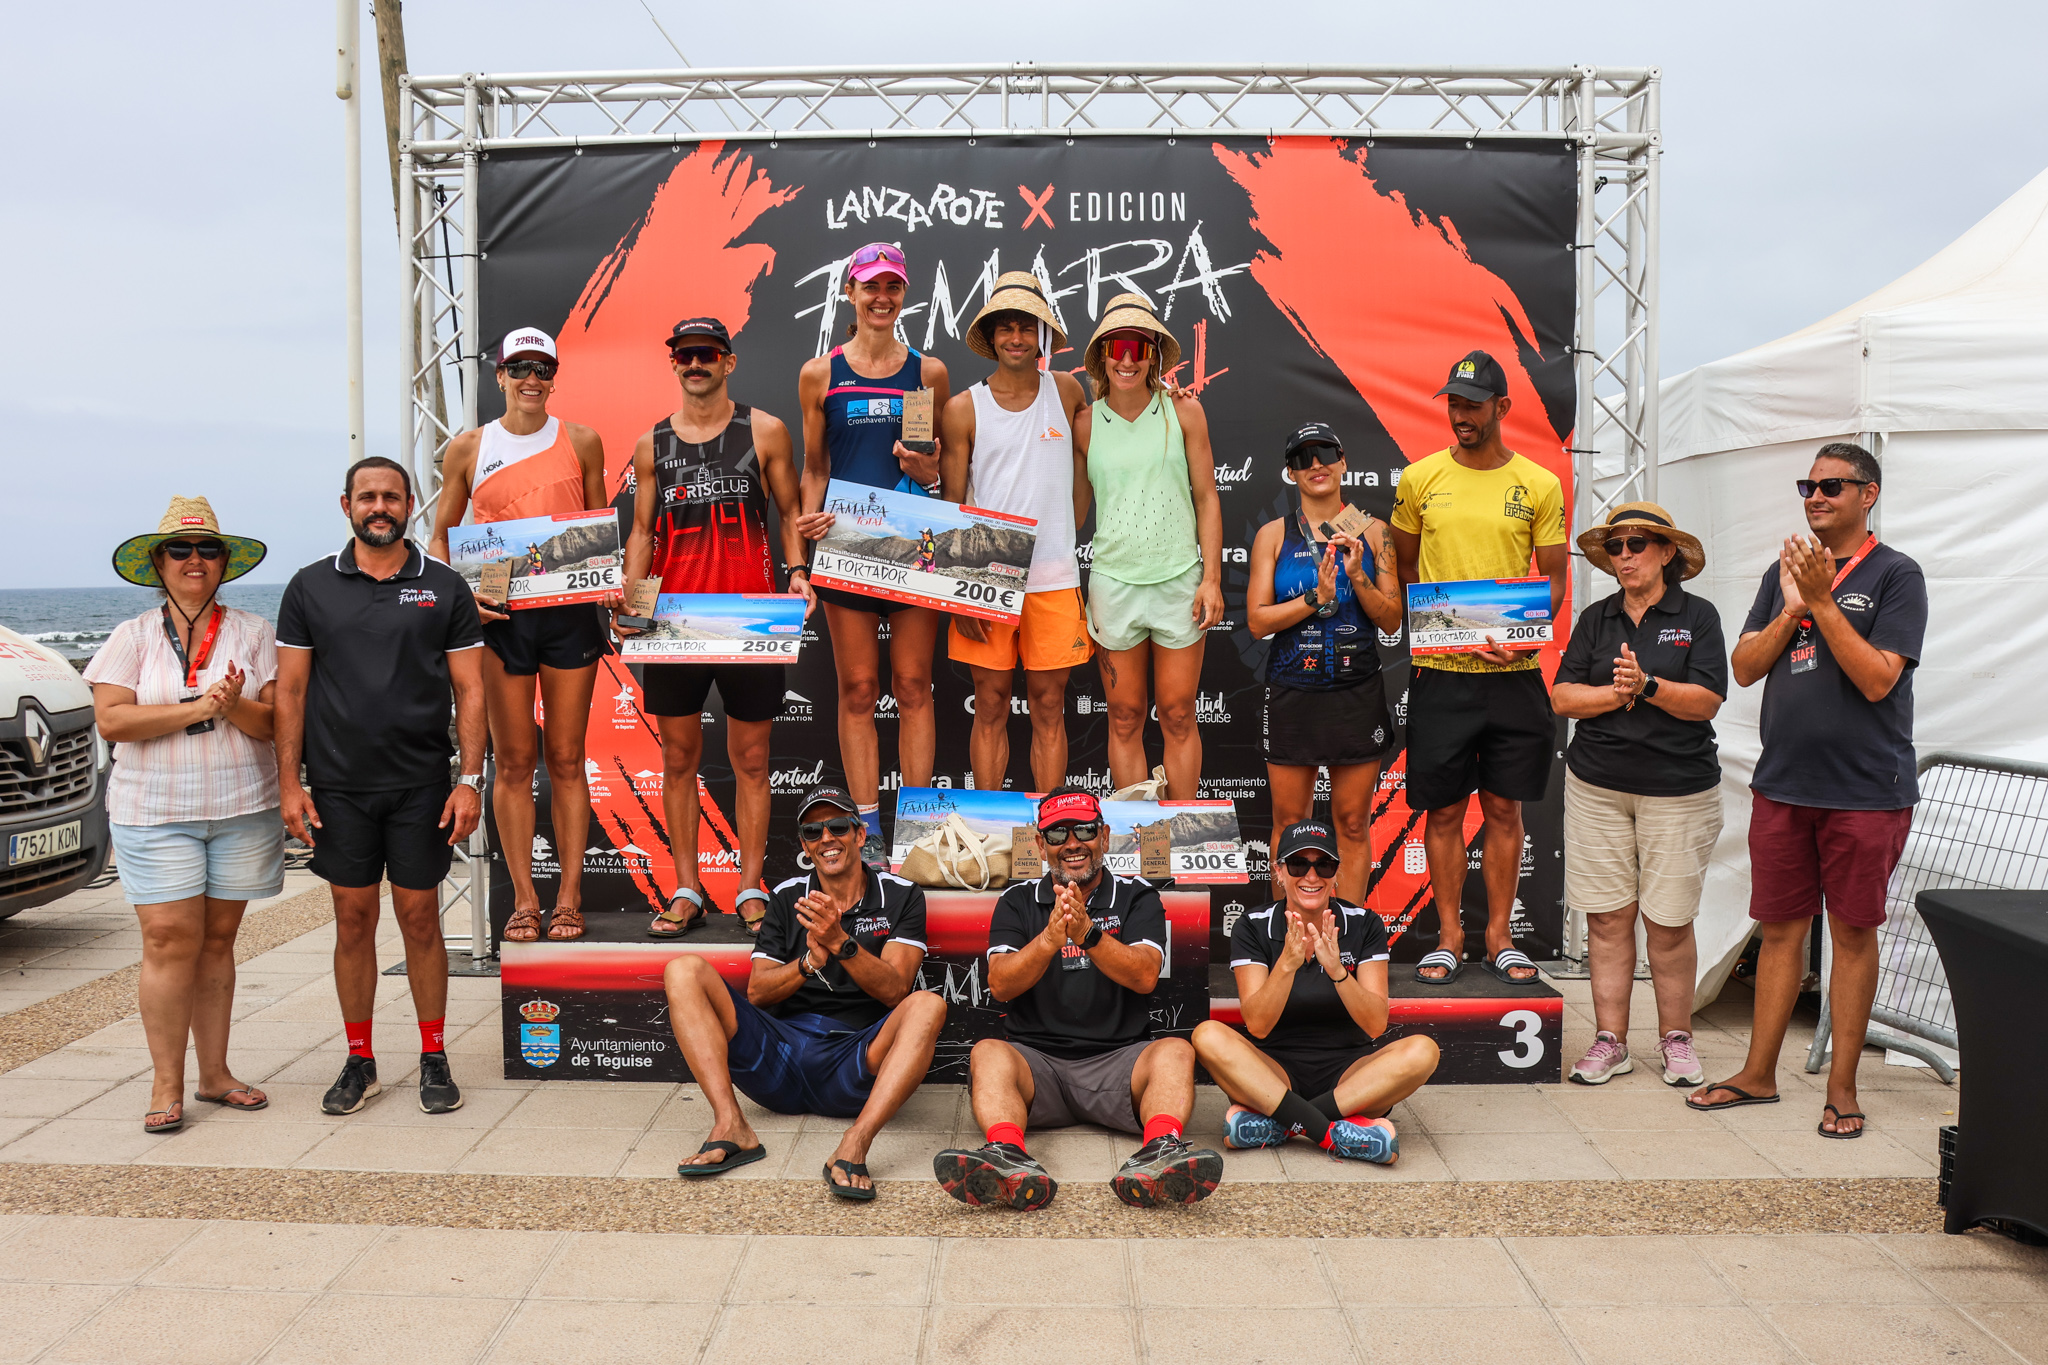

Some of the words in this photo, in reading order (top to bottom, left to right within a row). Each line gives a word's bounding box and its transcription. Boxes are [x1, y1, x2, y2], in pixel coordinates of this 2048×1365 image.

[826, 183, 1006, 232] LANZAROTE
[1070, 192, 1186, 222] EDICION
[515, 335, 545, 347] 226ERS
[847, 417, 886, 425] Crosshaven
[887, 416, 896, 424] Tri
[483, 459, 504, 475] HOKA
[664, 458, 687, 469] GOBIK
[1281, 466, 1379, 487] Cura
[829, 498, 890, 517] FAMARA
[458, 536, 506, 560] FAMARA
[588, 558, 599, 566] 50
[601, 557, 614, 565] km
[862, 552, 890, 564] residente
[817, 554, 832, 570] AL
[837, 559, 908, 585] PORTADOR
[990, 563, 1003, 573] 50
[1005, 565, 1020, 577] km
[566, 568, 614, 589] 250€
[399, 592, 438, 605] FAMARA
[953, 580, 1016, 608] 200€
[1411, 592, 1451, 609] FAMARA
[1416, 634, 1427, 644] AL
[1429, 631, 1478, 643] PORTADOR
[1507, 626, 1547, 639] 200€
[630, 642, 643, 651] AL
[647, 641, 707, 652] PORTADOR
[742, 640, 794, 653] 250€
[1791, 645, 1816, 663] STAFF
[1380, 781, 1392, 790] de
[1196, 789, 1209, 799] de
[1213, 789, 1256, 800] Teguise
[901, 799, 960, 817] FAMARA
[20, 831, 53, 859] 7521
[58, 825, 79, 851] KDN
[1207, 842, 1218, 850] 50
[583, 857, 653, 867] LANZAROTE
[1182, 854, 1238, 870] 300€
[1399, 914, 1413, 922] de
[855, 920, 891, 936] FAMARA
[570, 1037, 665, 1053] Ayuntamiento
[1497, 1009, 1543, 1068] 3
[571, 1053, 590, 1067] de
[594, 1053, 653, 1070] Teguise
